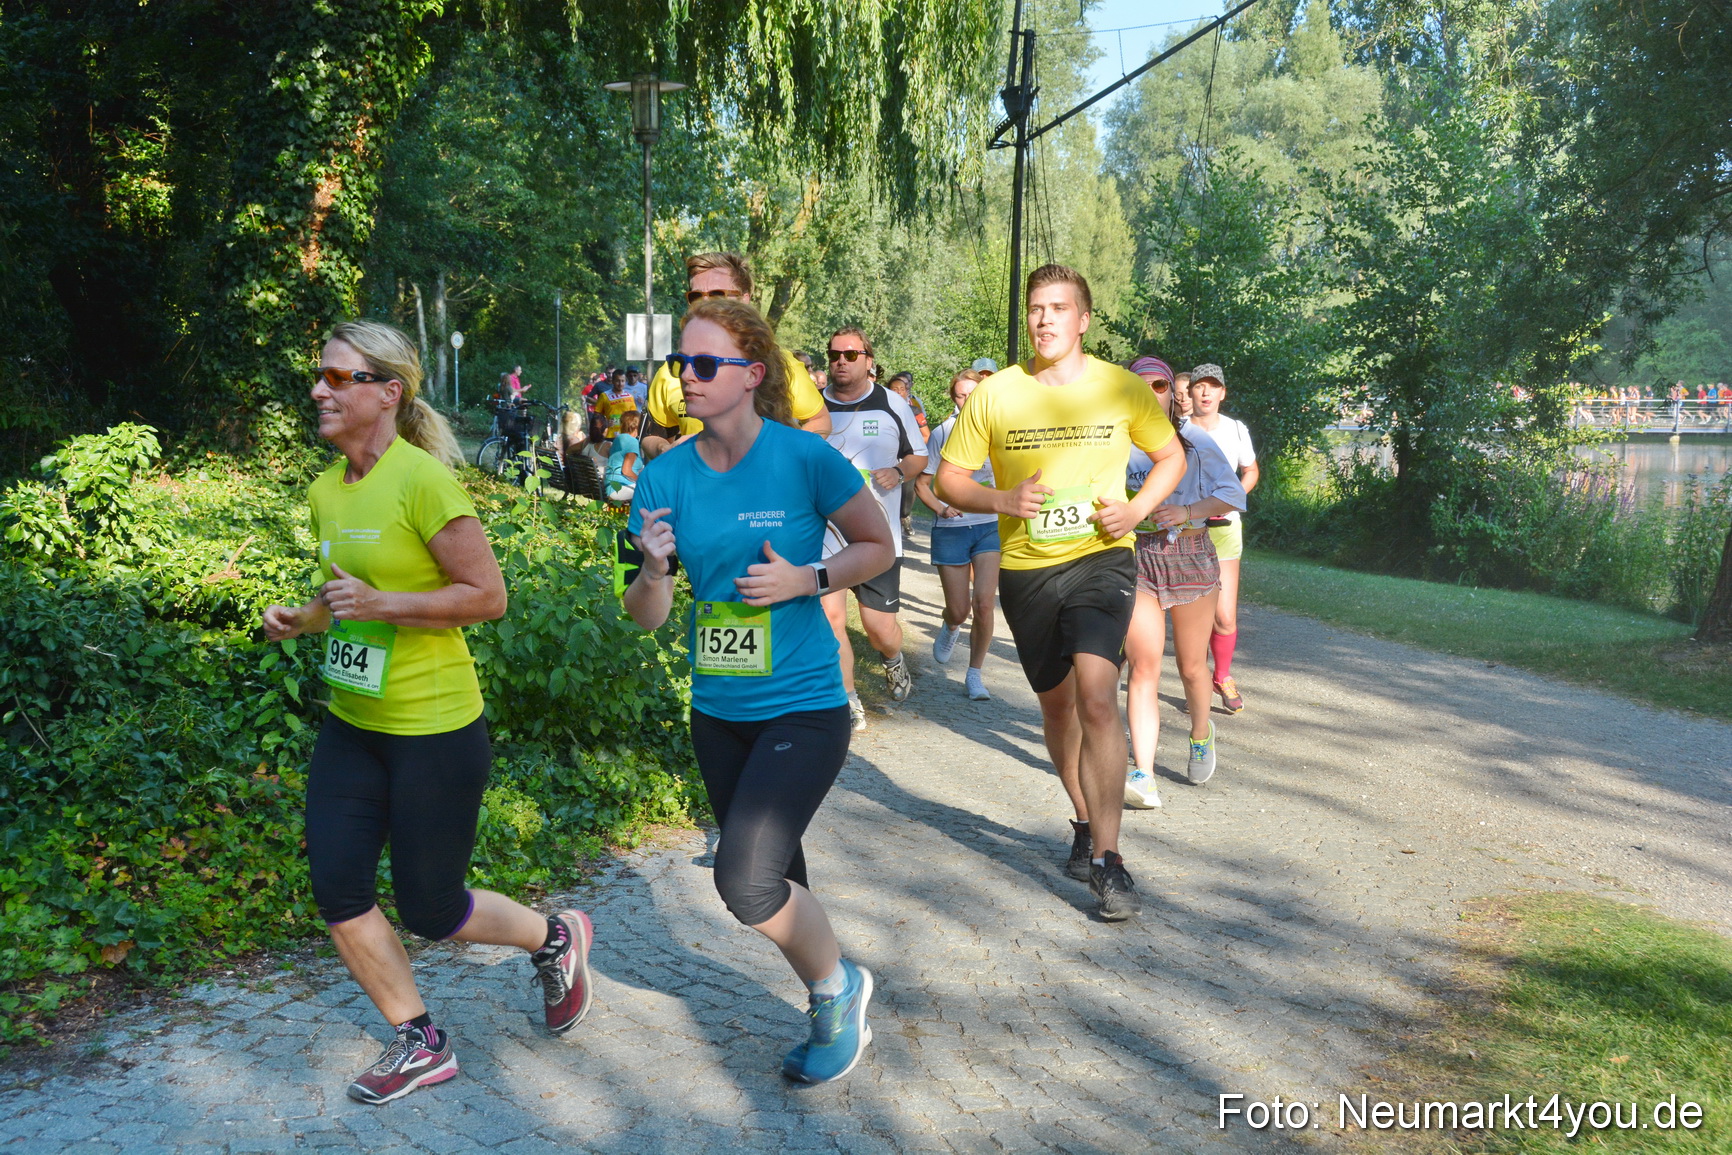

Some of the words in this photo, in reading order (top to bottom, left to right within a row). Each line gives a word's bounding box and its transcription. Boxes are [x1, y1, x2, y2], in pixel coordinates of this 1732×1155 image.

[1042, 441, 1082, 449] KOMPETENZ
[745, 510, 786, 519] PFLEIDERER
[1039, 506, 1080, 528] 733
[750, 520, 783, 528] Marlene
[699, 627, 757, 655] 1524
[330, 639, 369, 673] 964
[702, 654, 720, 662] Simon
[341, 670, 369, 682] Elisabeth
